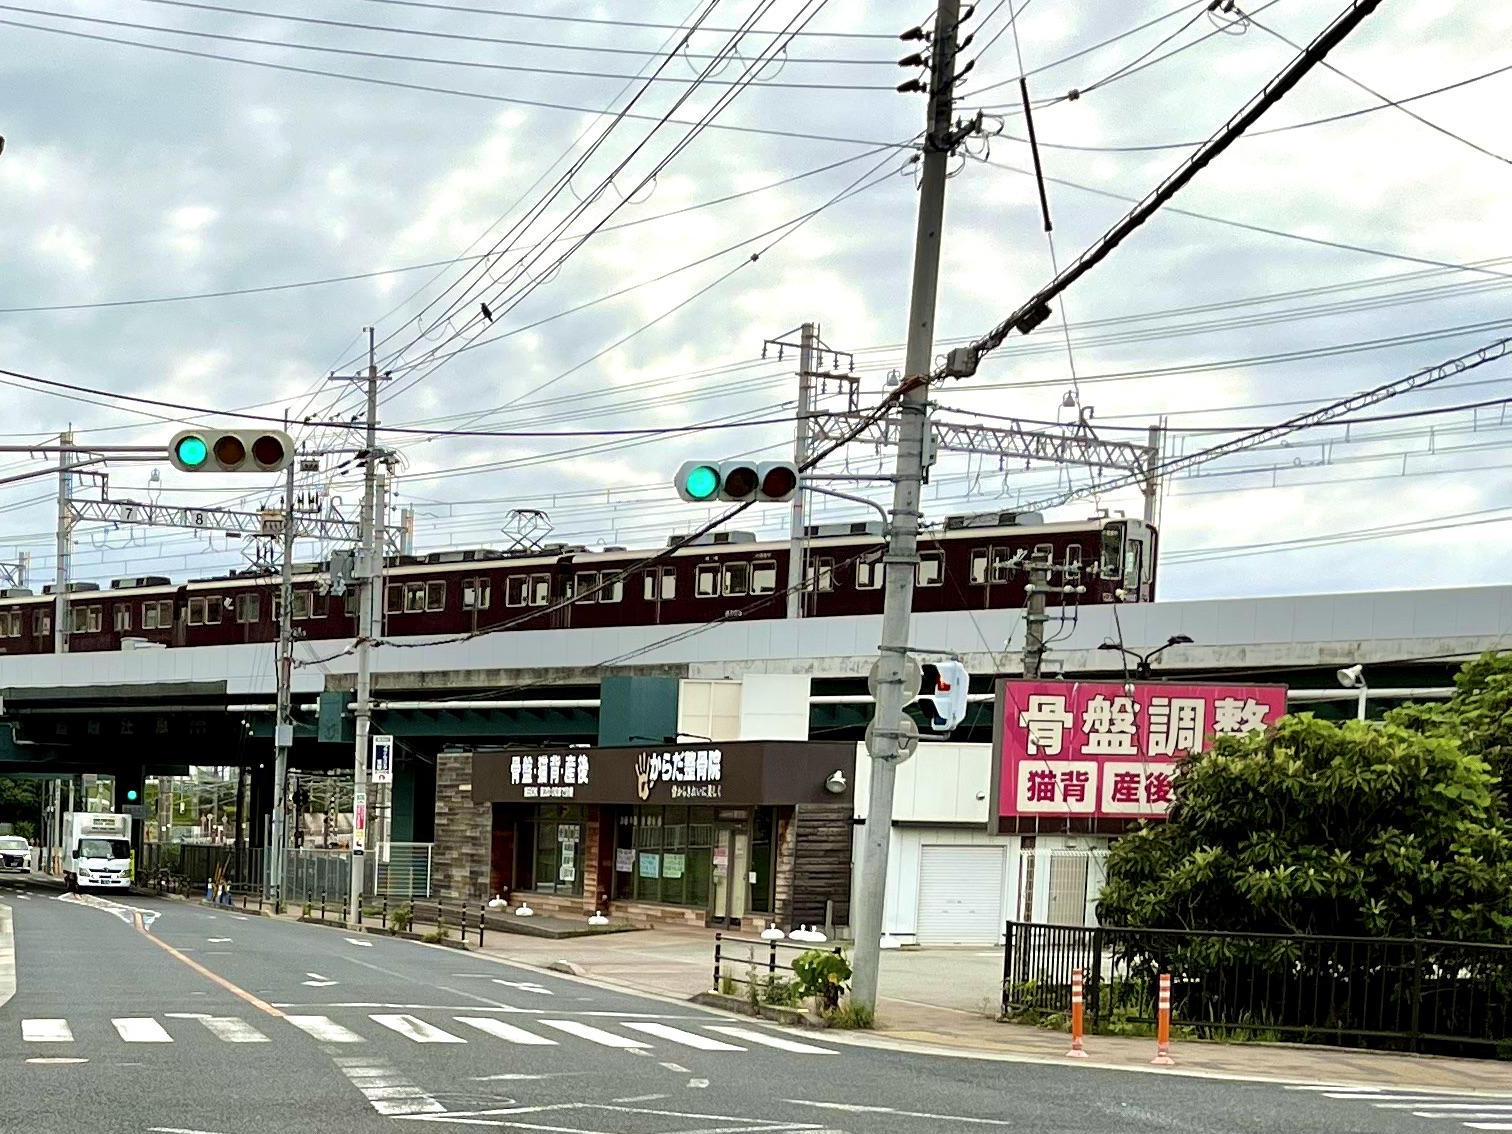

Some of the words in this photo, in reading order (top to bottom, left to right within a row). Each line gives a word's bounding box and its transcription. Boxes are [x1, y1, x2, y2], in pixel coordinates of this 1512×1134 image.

[125, 507, 133, 519] 7
[195, 513, 204, 525] 8
[1019, 694, 1269, 757] 骨盤調整
[648, 750, 722, 782] からだ整骨院
[1027, 771, 1089, 802] 猫背
[1112, 772, 1175, 803] 産後
